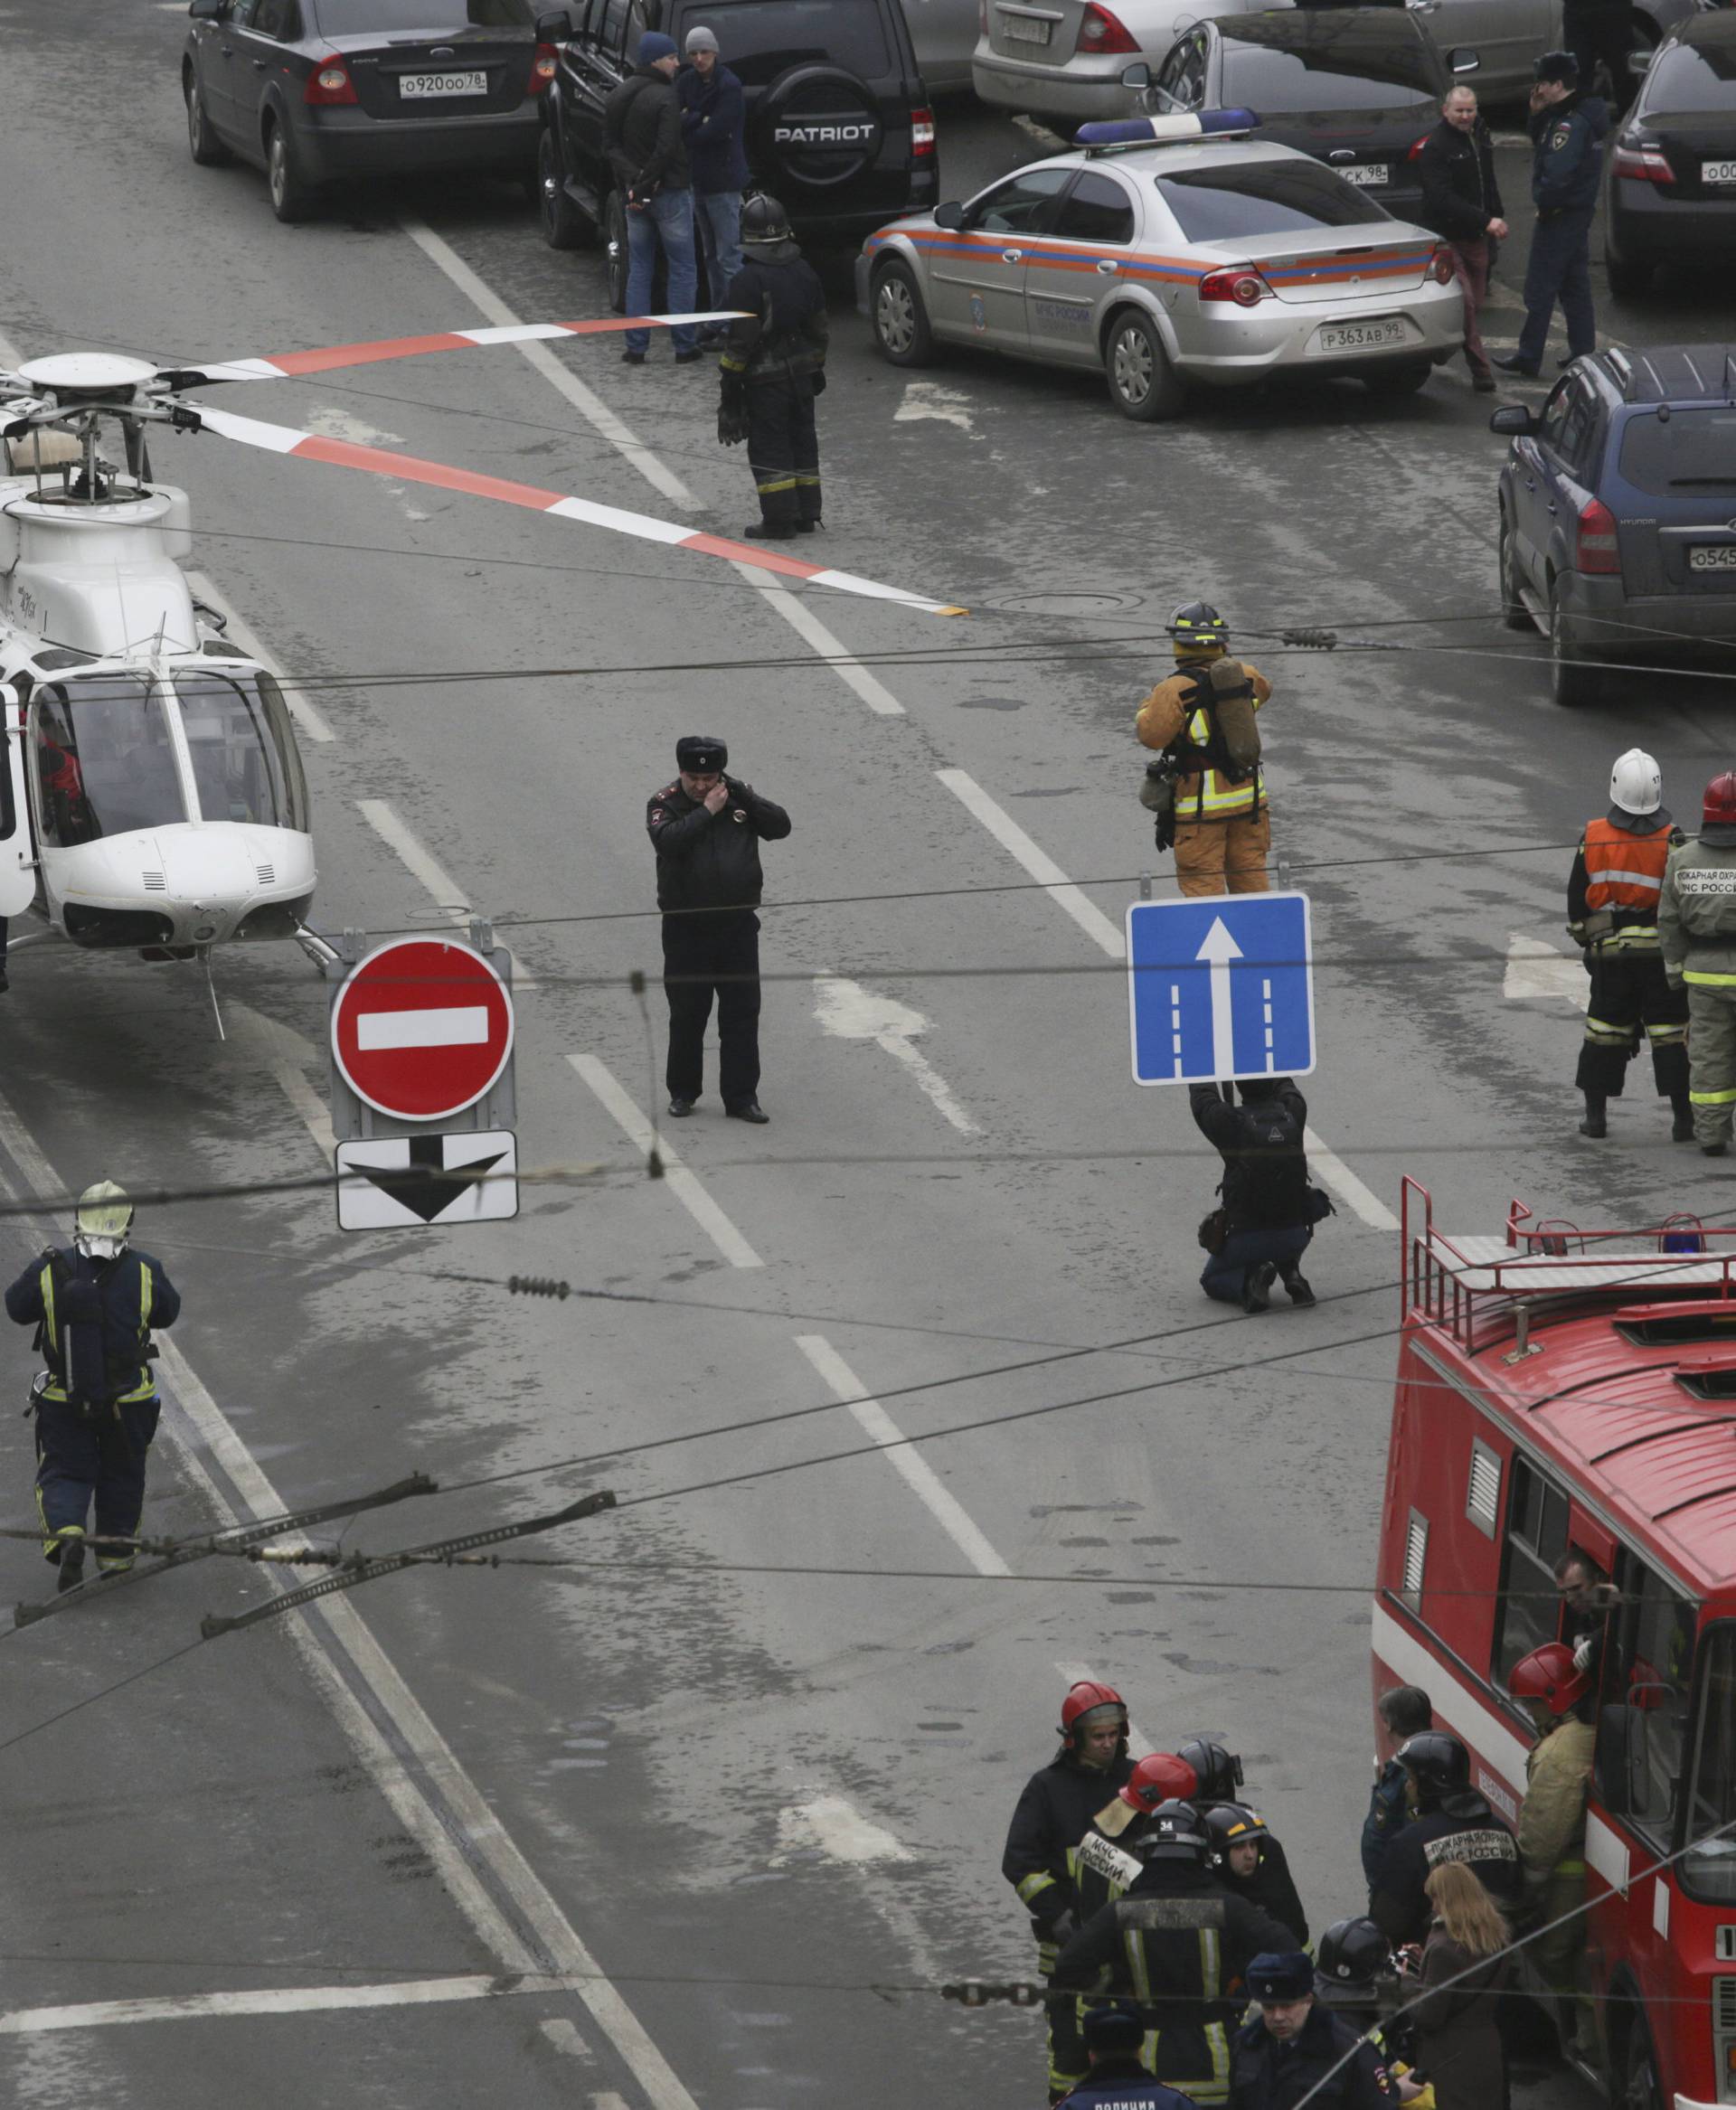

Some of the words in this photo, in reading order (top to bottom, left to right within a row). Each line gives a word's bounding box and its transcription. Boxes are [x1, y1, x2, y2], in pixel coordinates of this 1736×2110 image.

[775, 125, 874, 142] PATRIOT
[1159, 1821, 1174, 1832] 34
[1091, 1838, 1118, 1860] МЧС
